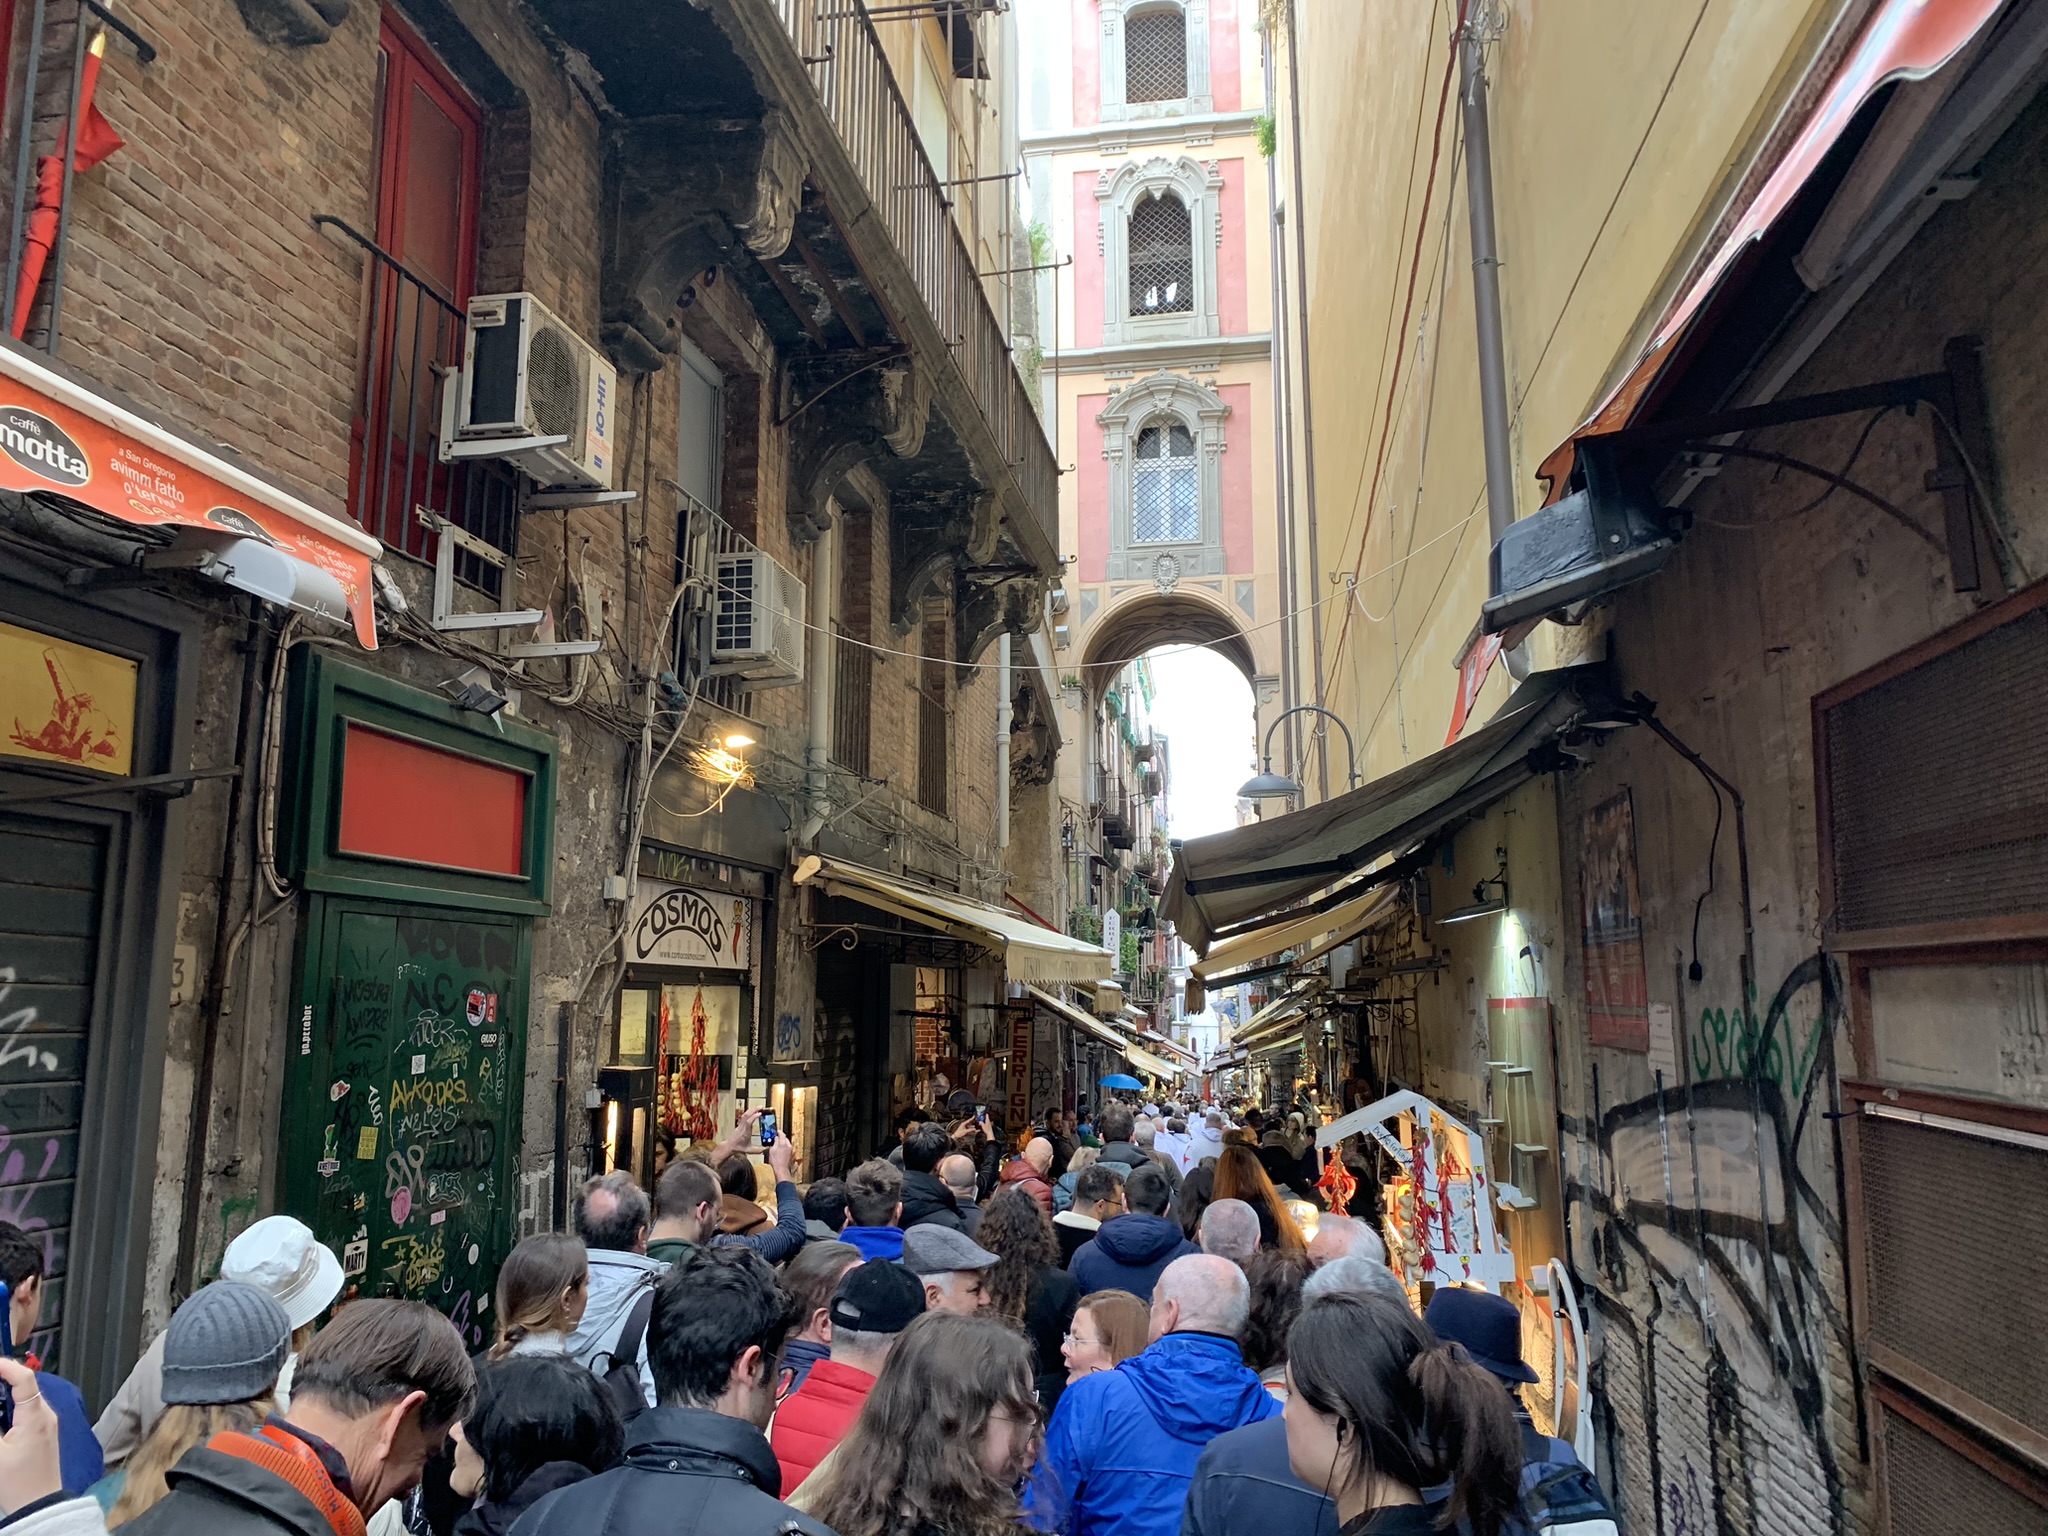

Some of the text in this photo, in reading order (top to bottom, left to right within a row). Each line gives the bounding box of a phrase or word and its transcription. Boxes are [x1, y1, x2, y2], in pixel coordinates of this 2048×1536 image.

[10, 415, 41, 436] caffè
[0, 423, 89, 480] motta
[125, 449, 142, 465] San
[142, 456, 177, 481] Gregorio
[110, 457, 186, 504] avimm fatto
[221, 514, 245, 530] caffè
[302, 535, 314, 547] San
[636, 894, 723, 960] COSMOS
[345, 1250, 366, 1274] MARTY
